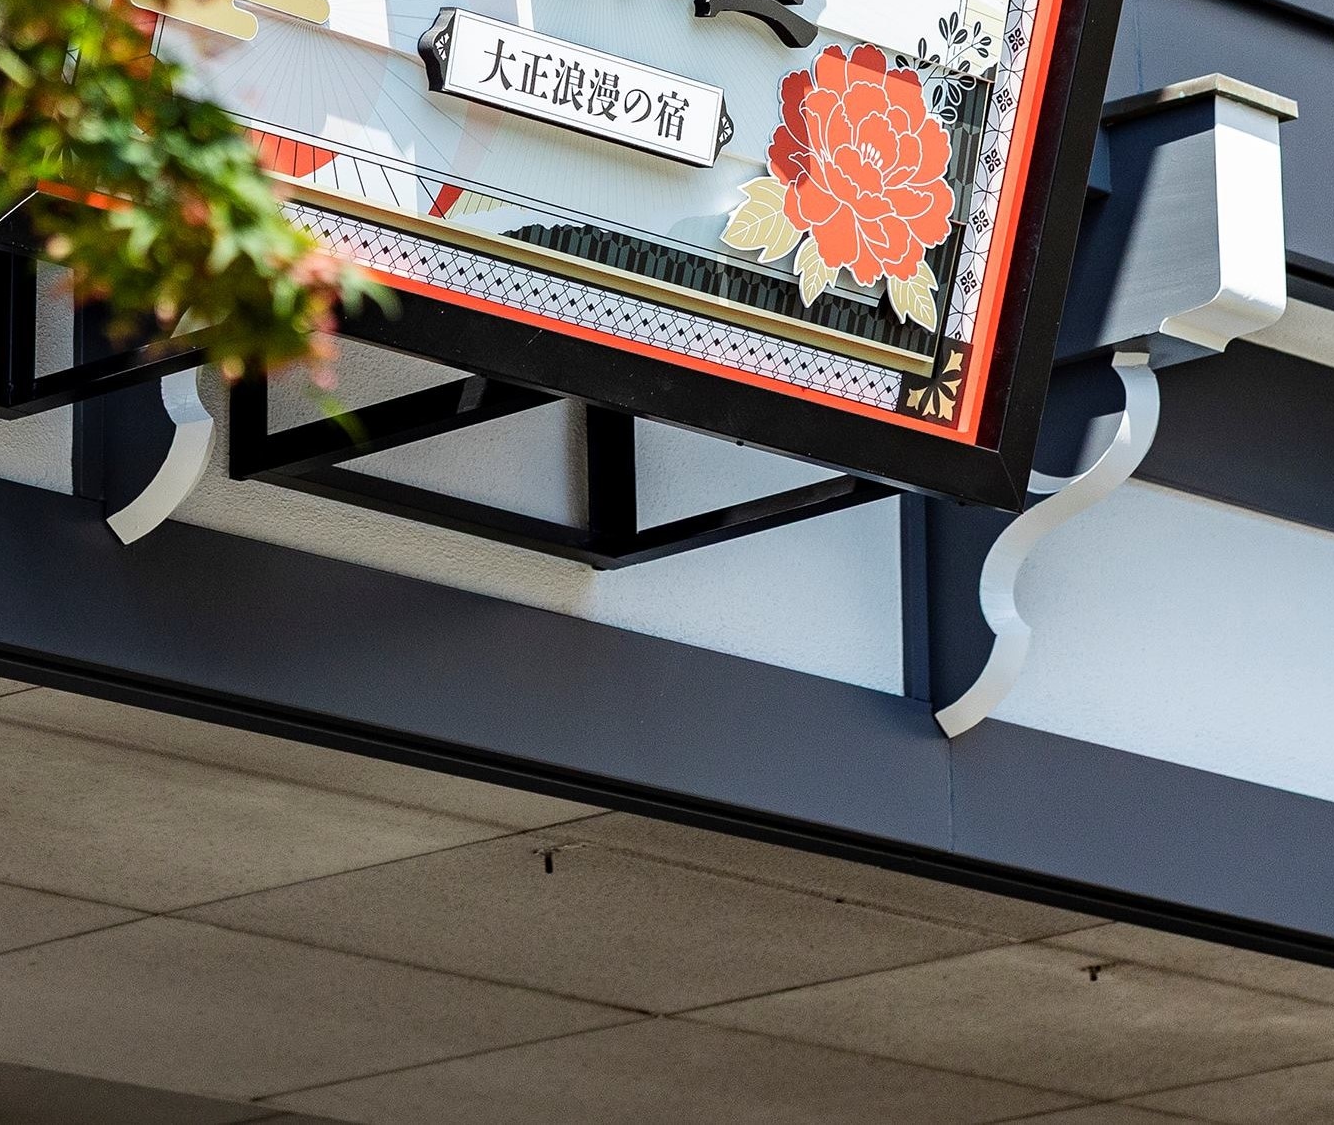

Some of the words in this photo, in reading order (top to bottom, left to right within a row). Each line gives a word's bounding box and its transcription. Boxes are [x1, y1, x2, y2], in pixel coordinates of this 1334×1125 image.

[479, 39, 690, 141] 大正浪漫の宿
